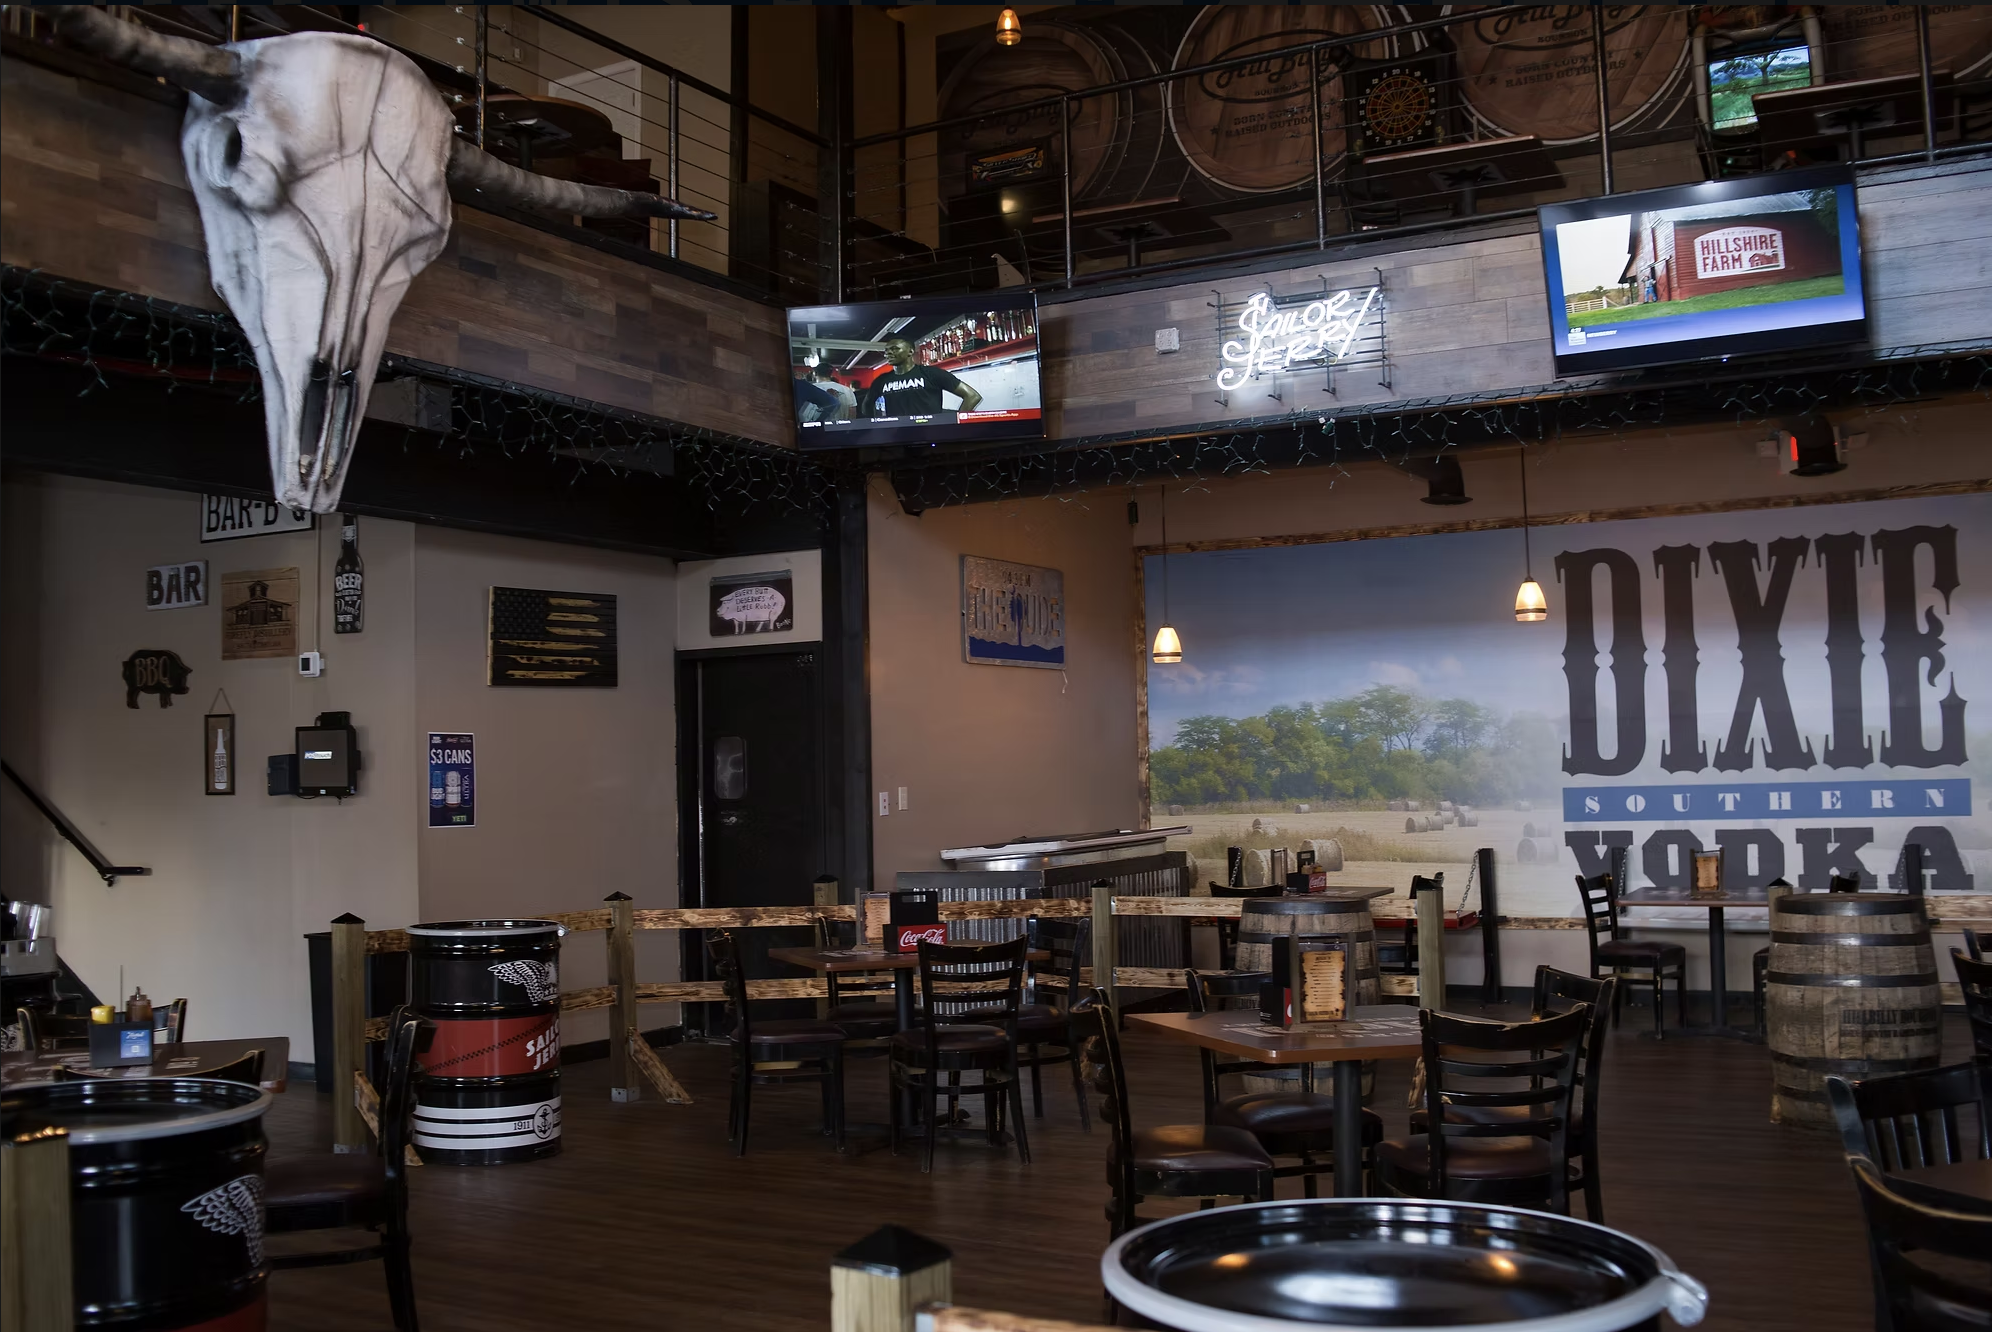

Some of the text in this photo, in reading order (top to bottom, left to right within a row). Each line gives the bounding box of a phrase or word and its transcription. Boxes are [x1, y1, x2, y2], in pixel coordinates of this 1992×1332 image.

[1505, 72, 1553, 88] RAISED
[1700, 233, 1778, 256] HILLSHIRE
[1702, 253, 1743, 273] FARM
[1228, 290, 1355, 354] SAILOR
[1217, 296, 1378, 391] JERRY
[882, 377, 925, 393] APEMAN
[147, 565, 201, 606] BAR
[335, 572, 363, 591] BEER
[735, 589, 753, 598] EVERY
[736, 595, 766, 605] DESERVES
[969, 584, 1008, 632] THE
[1554, 524, 1969, 777] DIXIE
[134, 656, 173, 689] BBQ
[430, 747, 472, 766] $3 CANS
[1584, 788, 1945, 814] SOUTHERN
[451, 814, 468, 823] YETI
[1564, 826, 1975, 890] VODKA
[513, 1120, 530, 1131] 1911
